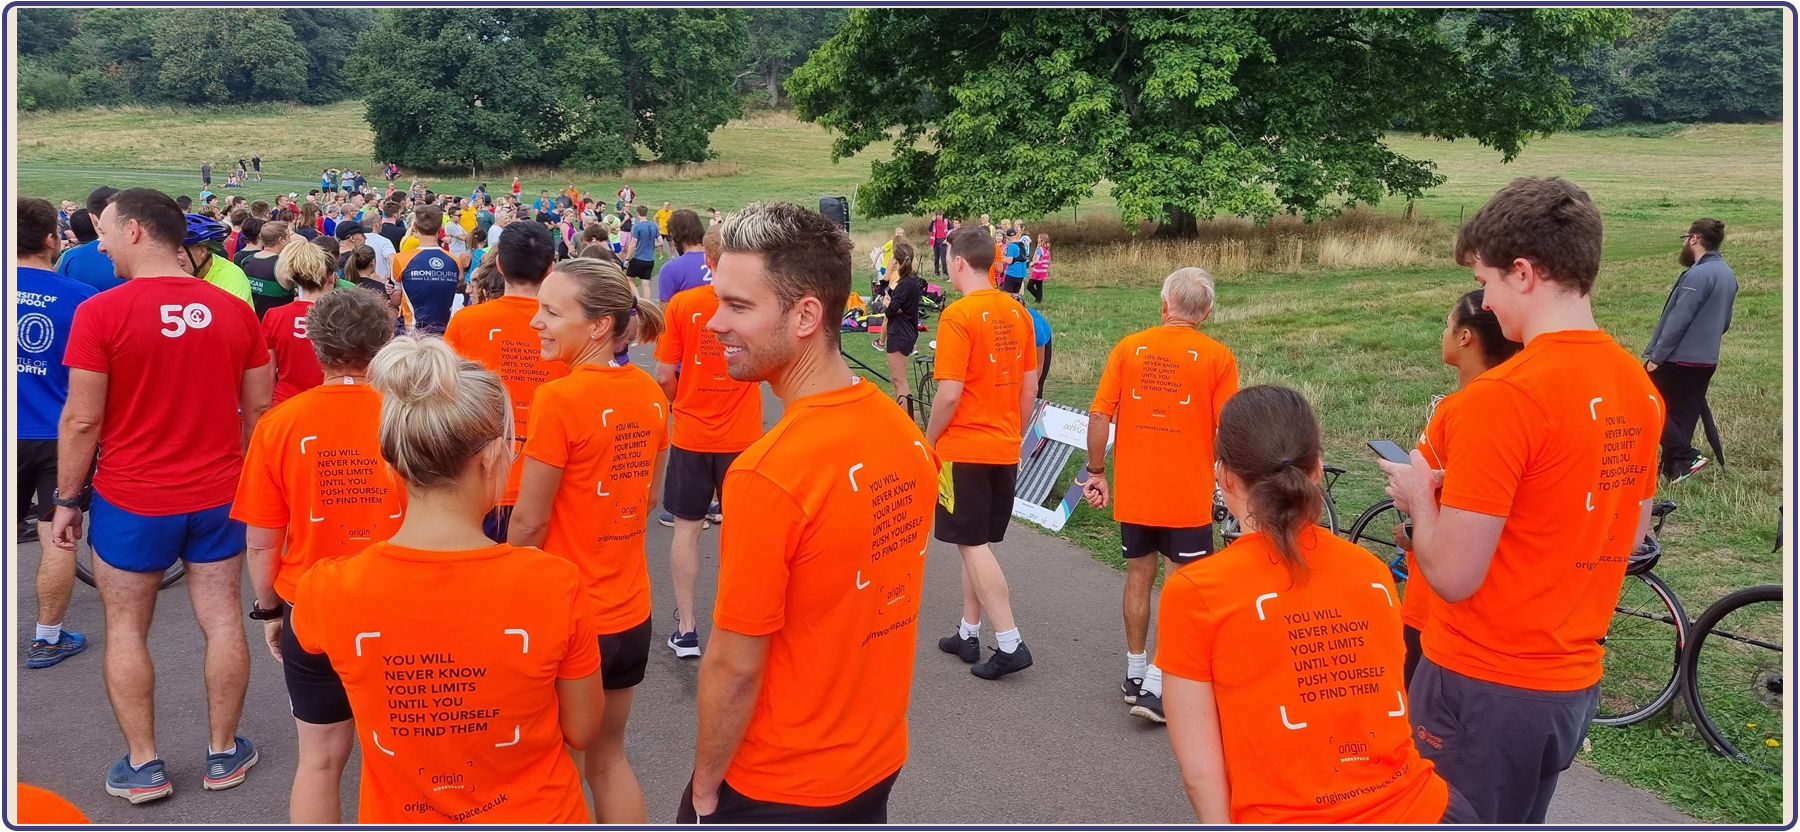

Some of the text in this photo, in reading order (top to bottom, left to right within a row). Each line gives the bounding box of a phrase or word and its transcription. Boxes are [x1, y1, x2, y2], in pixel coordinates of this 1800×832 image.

[411, 270, 458, 278] IRONBOURNE
[700, 264, 712, 281] 2
[293, 316, 307, 338] 5
[1156, 380, 1182, 388] YOURSELF
[615, 421, 639, 431] YOU WILL
[1605, 416, 1615, 425] YOU
[615, 429, 651, 441] NEVER KNOW
[1604, 429, 1622, 439] NEVER
[614, 440, 646, 451] YOUR LIMITS
[1603, 442, 1619, 452] YOUR
[318, 459, 347, 467] NEVER
[613, 453, 627, 461] UNTIL
[318, 469, 343, 477] YOUR
[611, 463, 625, 471] PUSH
[319, 479, 345, 487] UNTIL
[869, 472, 899, 493] YOU WILL
[1598, 482, 1610, 491] TO
[321, 488, 343, 497] PUSH
[872, 479, 916, 508] NEVER KNOW
[360, 496, 382, 504] THEM
[873, 494, 912, 522] YOUR LIMITS
[873, 510, 906, 536] UNTIL YOU
[349, 528, 370, 537] origin
[872, 516, 923, 550] PUSH YOURSELF
[871, 531, 917, 563] TO FIND THEM
[887, 583, 905, 599] origin
[1284, 608, 1342, 625] YOU WILL
[1288, 620, 1369, 640] NEVER KNOW
[1290, 636, 1364, 656] YOUR LIMITS
[383, 653, 455, 666] YOU WILL
[1294, 653, 1357, 671] UNTIL YOU
[385, 667, 486, 680] NEVER KNOW
[1297, 666, 1385, 687] PUSH YOURSELF
[385, 682, 476, 695] YOUR LIMITS
[1300, 682, 1379, 703] TO FIND THEM
[388, 697, 463, 709] UNTIL YOU
[389, 708, 500, 723] PUSH YOURSELF
[391, 722, 488, 736] TO FIND THEM
[1338, 741, 1368, 755] origin
[432, 773, 464, 784] origin
